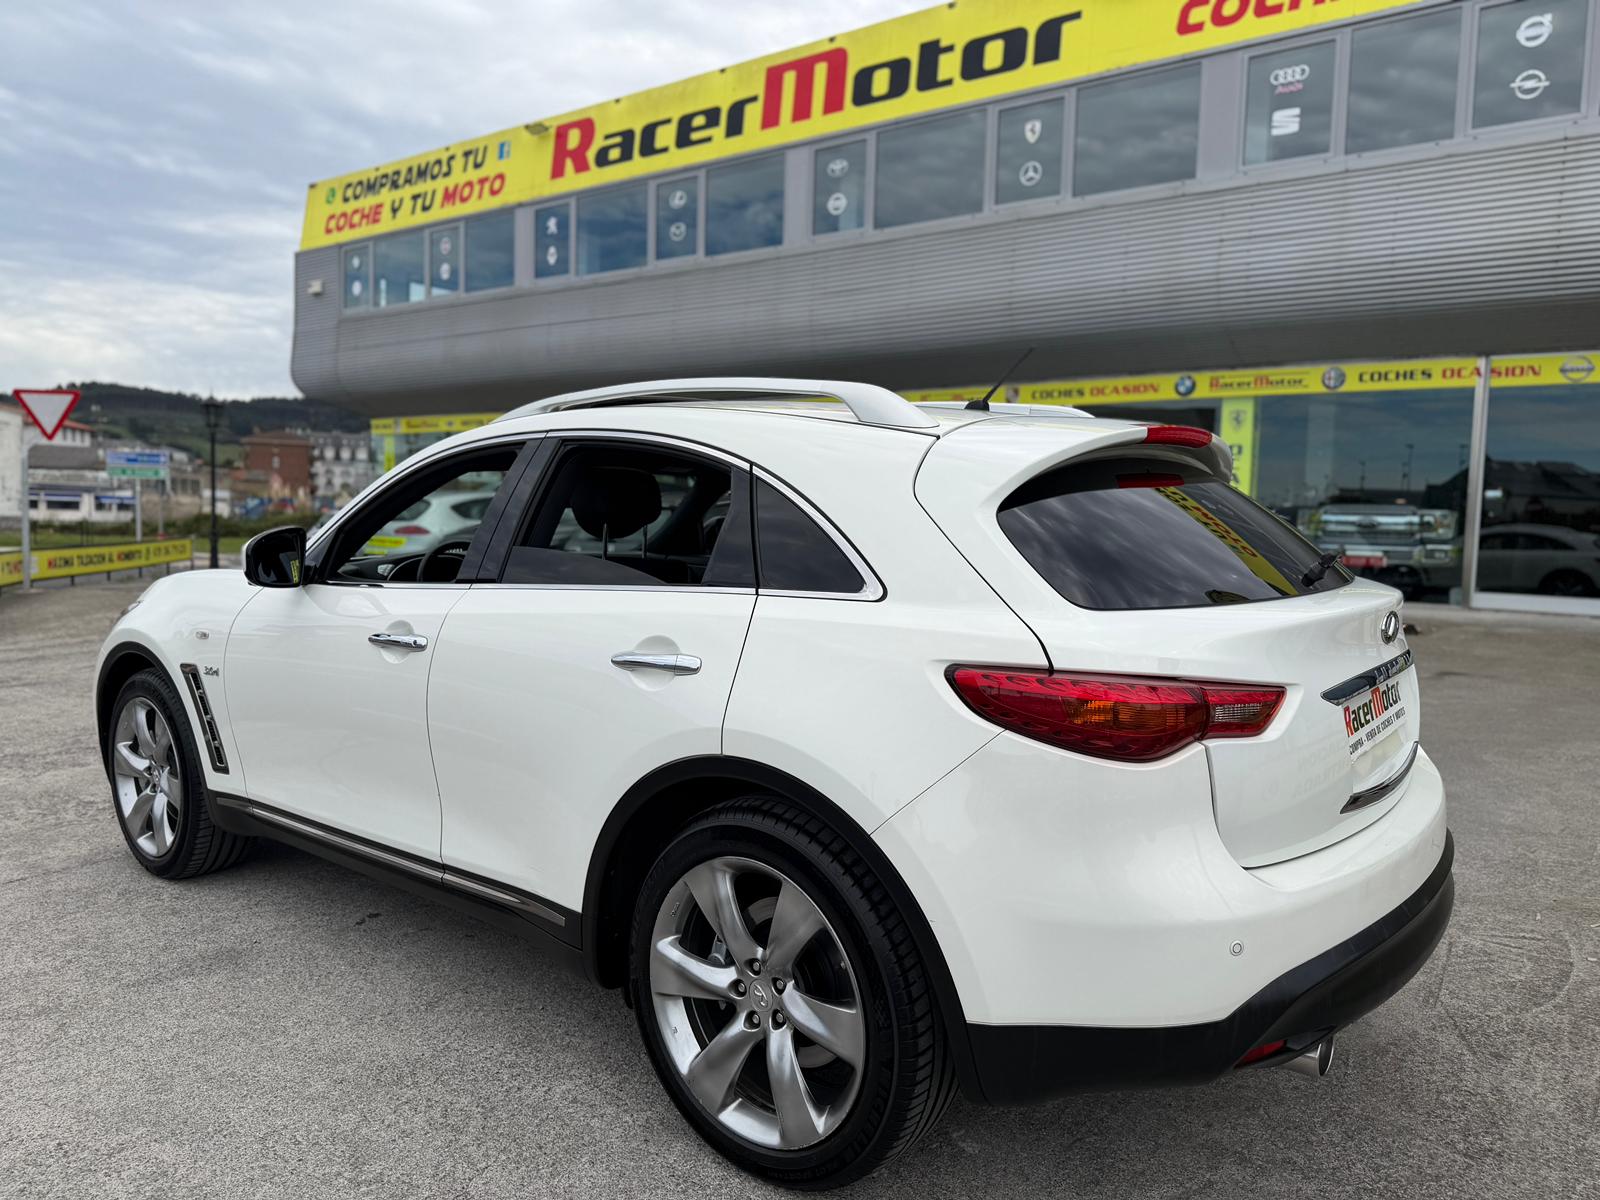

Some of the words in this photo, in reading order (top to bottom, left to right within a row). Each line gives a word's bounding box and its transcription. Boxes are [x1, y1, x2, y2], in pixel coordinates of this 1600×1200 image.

[549, 10, 1083, 181] RacerMotor
[324, 203, 384, 235] COCHE
[389, 198, 404, 219] Y
[410, 190, 437, 216] TU
[440, 172, 506, 209] MOTO
[342, 154, 455, 204] COMPRAMOS
[461, 146, 488, 173] TU
[1031, 388, 1085, 400] COCHES
[1090, 383, 1161, 398] OCASION
[1358, 368, 1433, 383] COCHES
[1441, 364, 1542, 379] OCASION
[1343, 681, 1402, 738] RacerMotor
[1348, 737, 1364, 755] COMPRA
[1365, 728, 1377, 742] VENTA
[1376, 724, 1382, 734] DE
[1380, 715, 1394, 731] COCHES
